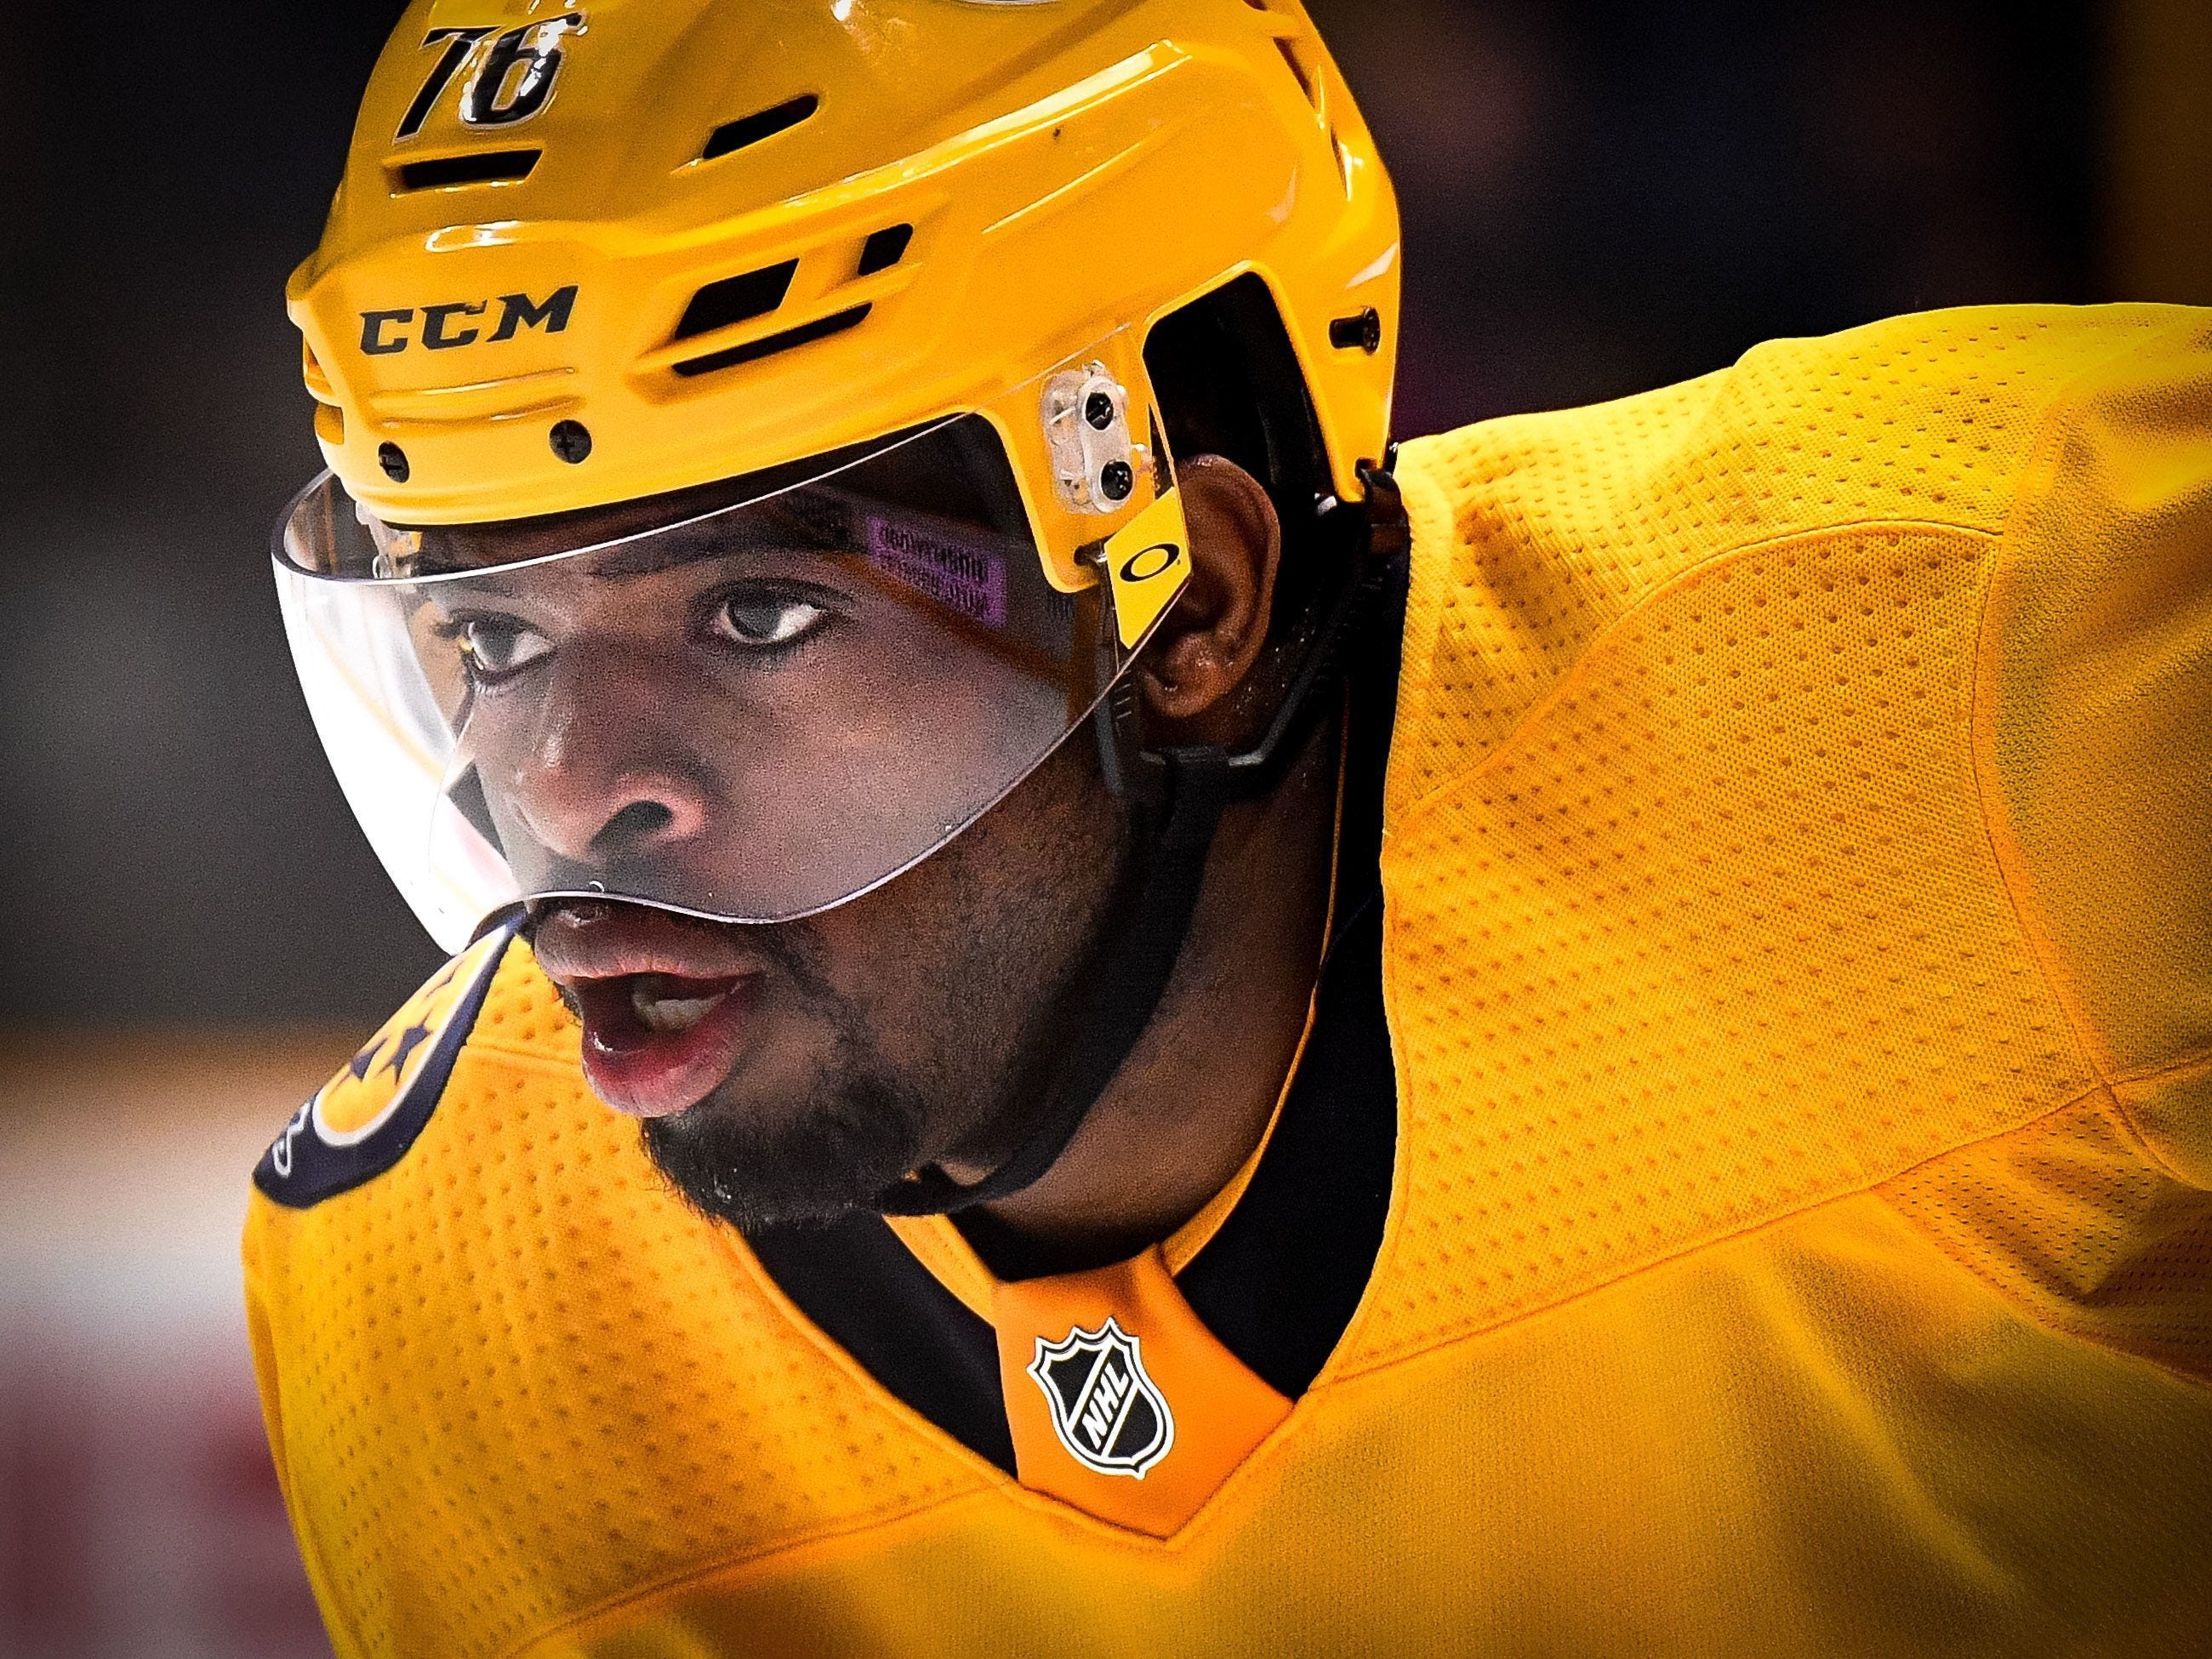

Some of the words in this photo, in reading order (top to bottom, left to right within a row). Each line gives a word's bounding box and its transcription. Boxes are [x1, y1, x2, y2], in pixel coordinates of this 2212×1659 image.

[393, 11, 587, 144] 76
[360, 285, 579, 356] CCM
[1082, 1362, 1129, 1450] NHL
